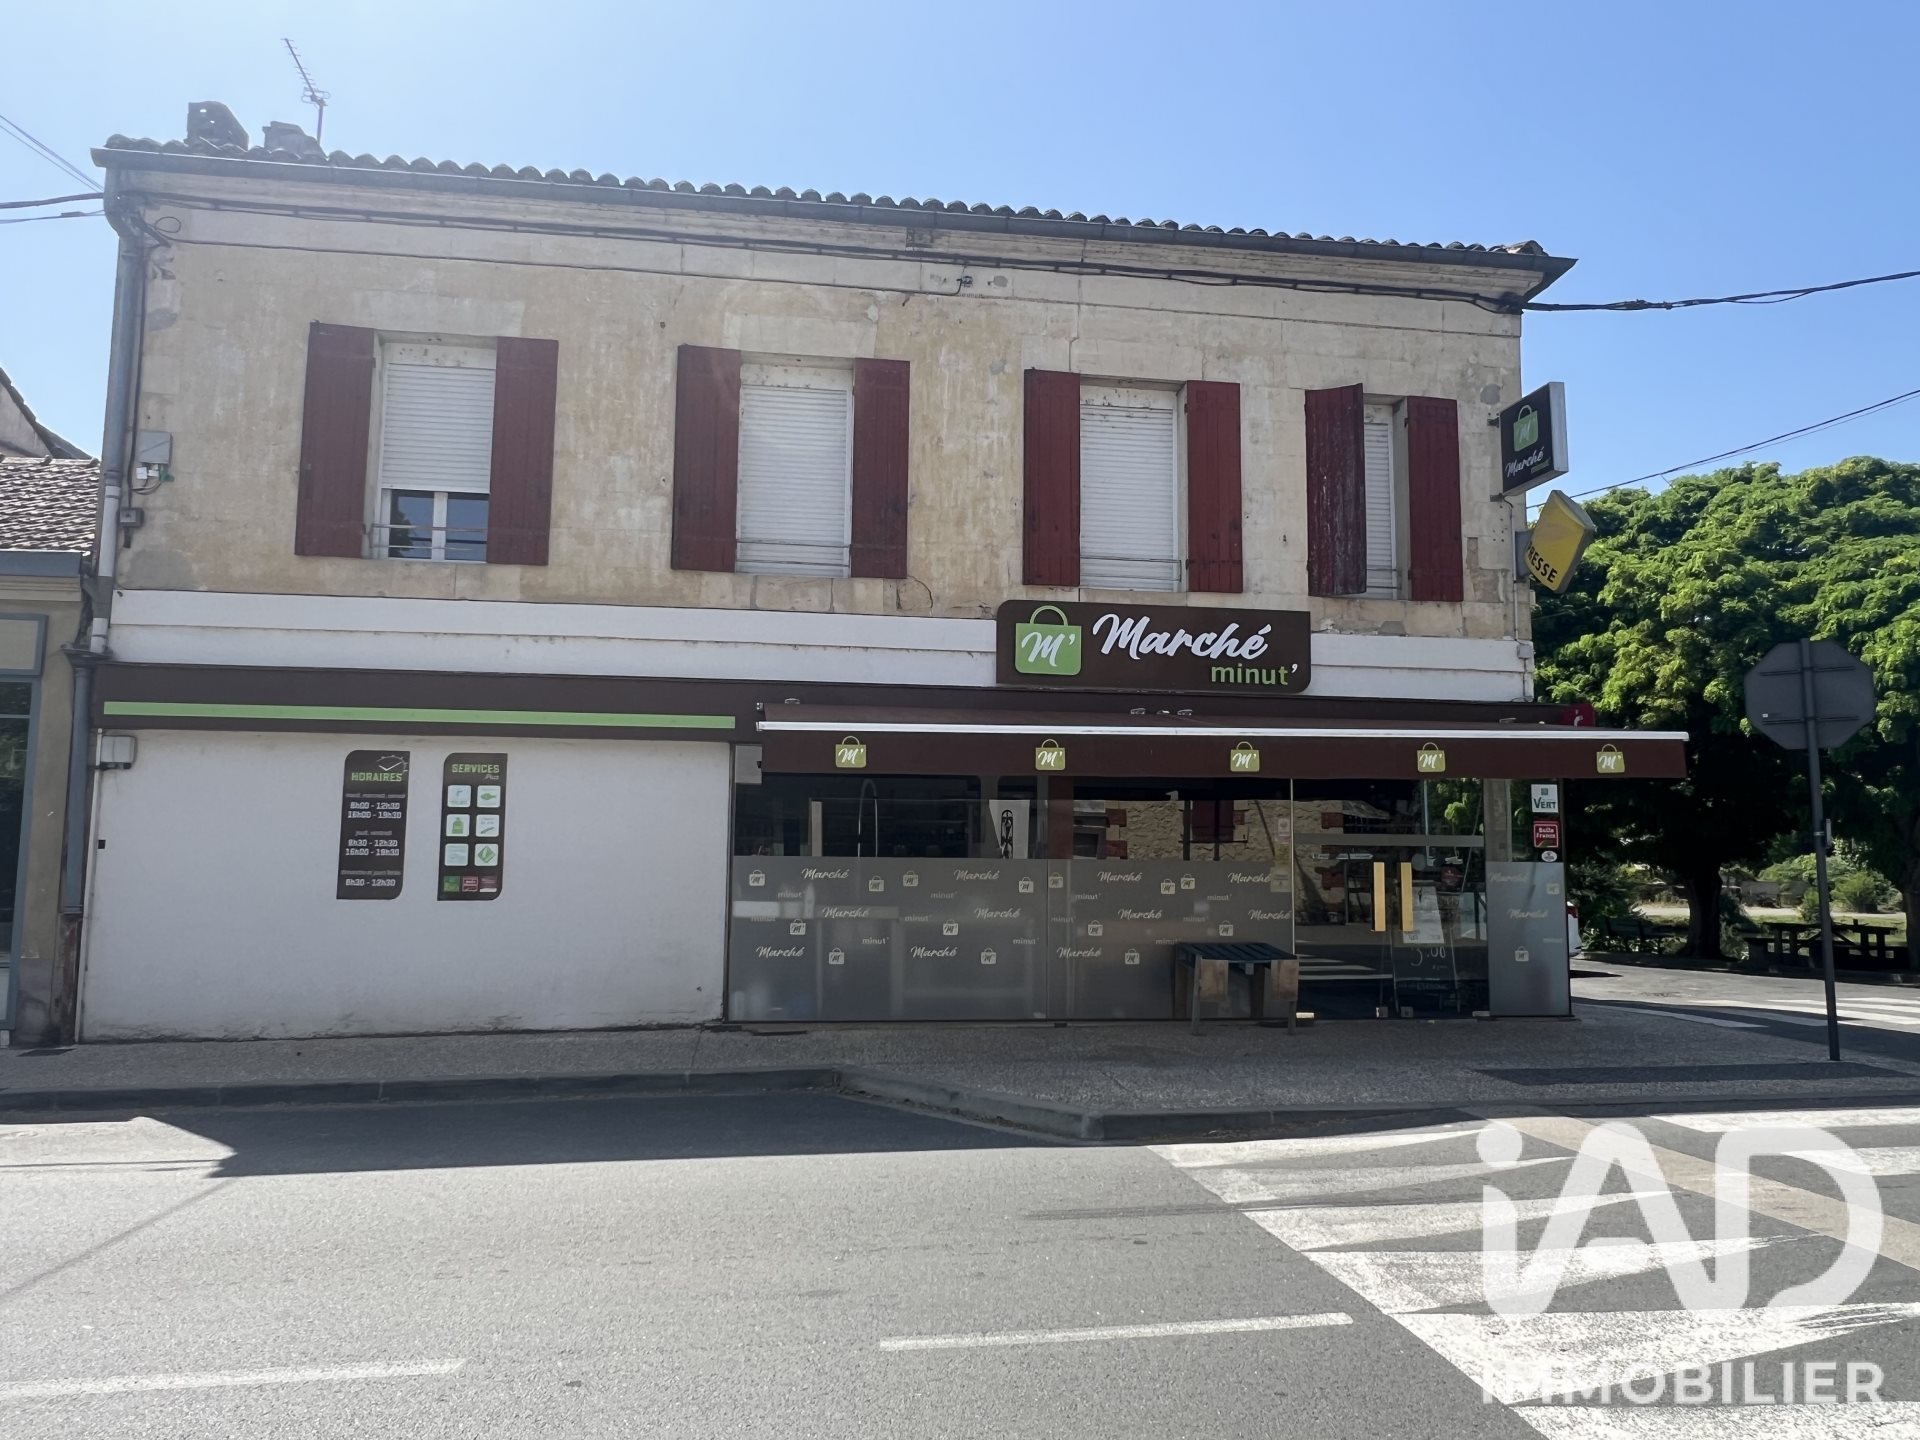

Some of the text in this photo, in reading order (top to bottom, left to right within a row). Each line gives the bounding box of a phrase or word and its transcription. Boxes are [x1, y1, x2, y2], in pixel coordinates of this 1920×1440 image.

[1505, 446, 1545, 478] Marché
[1093, 613, 1271, 660] Marché
[1021, 631, 1075, 667] M'
[1211, 663, 1298, 686] minut'
[451, 763, 500, 773] SERVICES
[351, 772, 403, 782] HORAIRES
[801, 868, 850, 880] Marché
[953, 869, 1000, 881] Marché
[1097, 871, 1143, 883] Marché
[1228, 872, 1271, 883] Marché
[822, 906, 870, 919] Marché
[974, 907, 1022, 919] Marché
[1118, 909, 1163, 920] Marché
[1248, 909, 1292, 920] Marché
[755, 946, 805, 958] Marché
[910, 946, 958, 958] Marché
[1057, 947, 1102, 958] Marché
